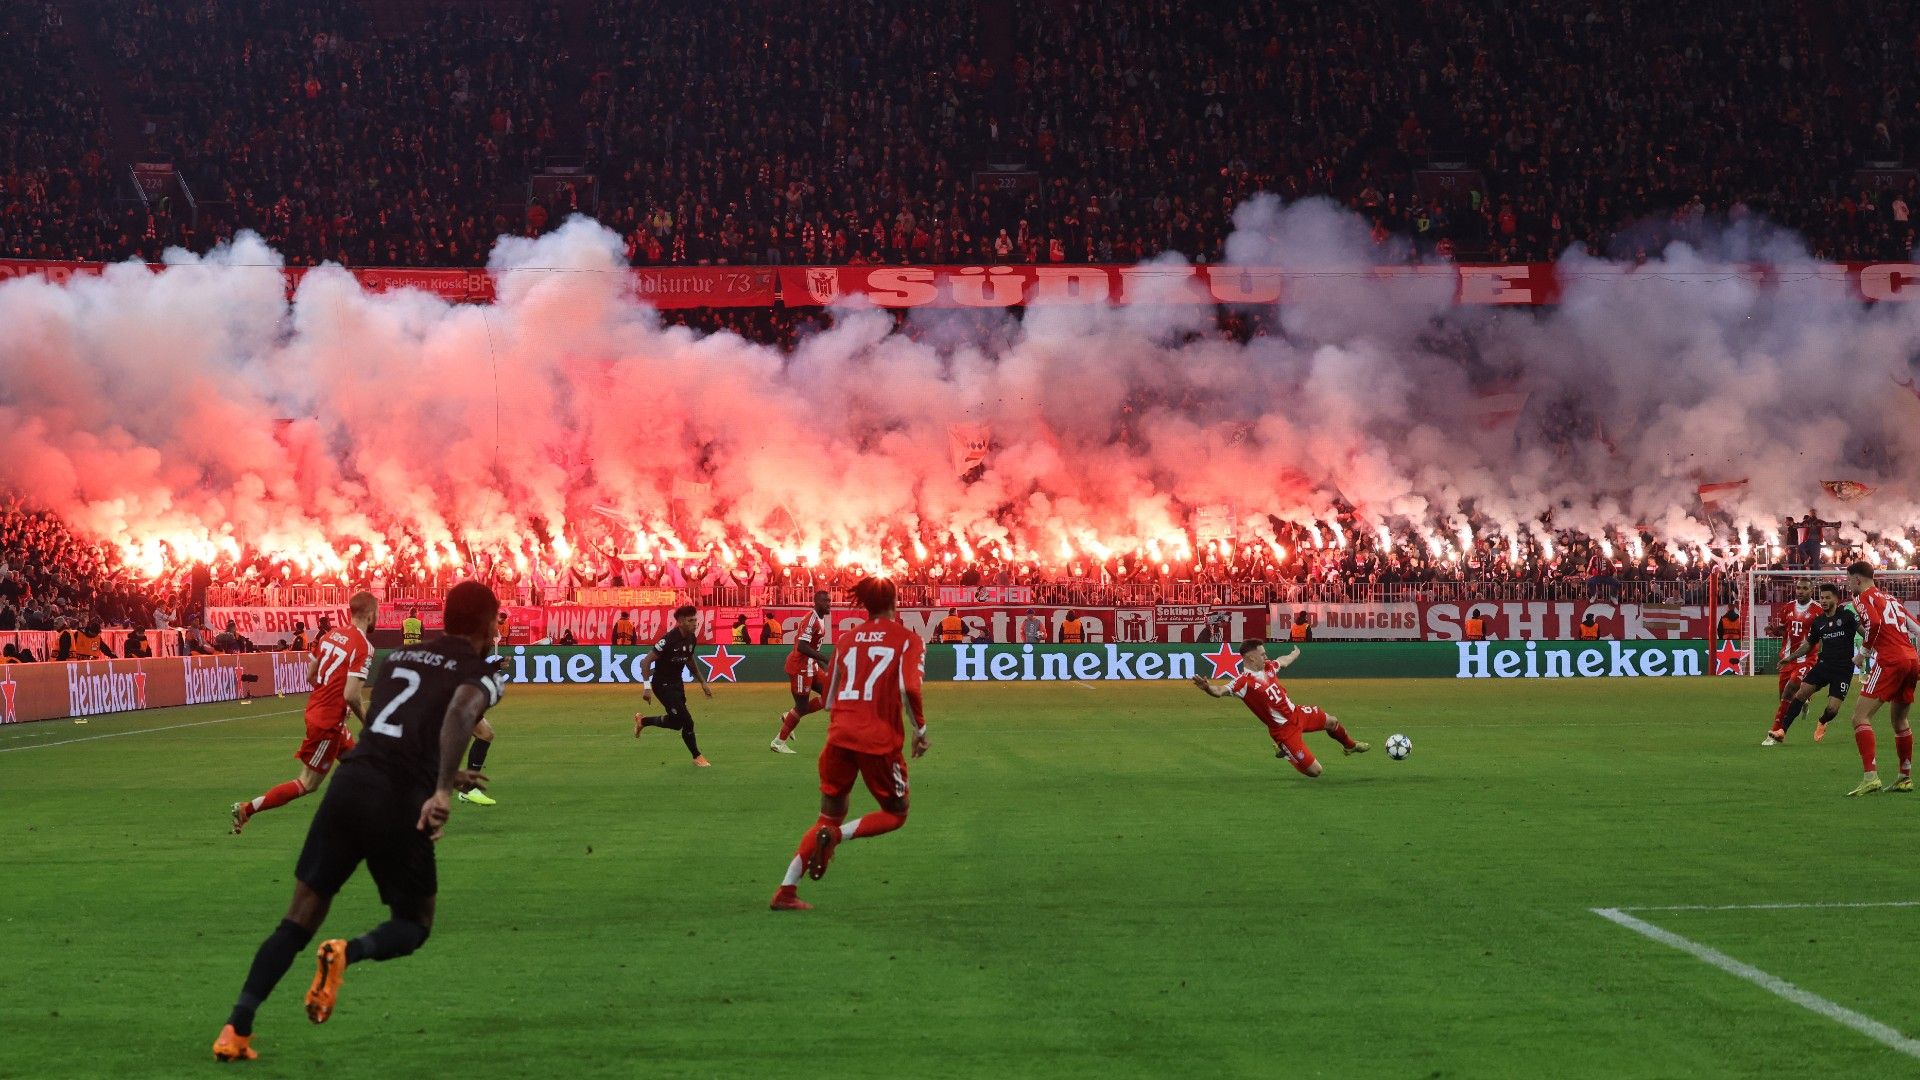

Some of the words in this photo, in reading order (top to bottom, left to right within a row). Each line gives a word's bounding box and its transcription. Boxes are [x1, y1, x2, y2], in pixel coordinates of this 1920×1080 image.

[666, 609, 714, 641] PDE
[1157, 606, 1195, 616] Sektion
[1883, 600, 1908, 633] 45
[855, 631, 886, 642] OLISE
[317, 640, 348, 686] 77
[838, 645, 895, 701] 17
[953, 643, 1196, 681] Heineken
[1456, 640, 1703, 677] Heineken
[67, 660, 136, 717] Heineken
[183, 655, 237, 705] Heineken
[369, 666, 421, 738] 2
